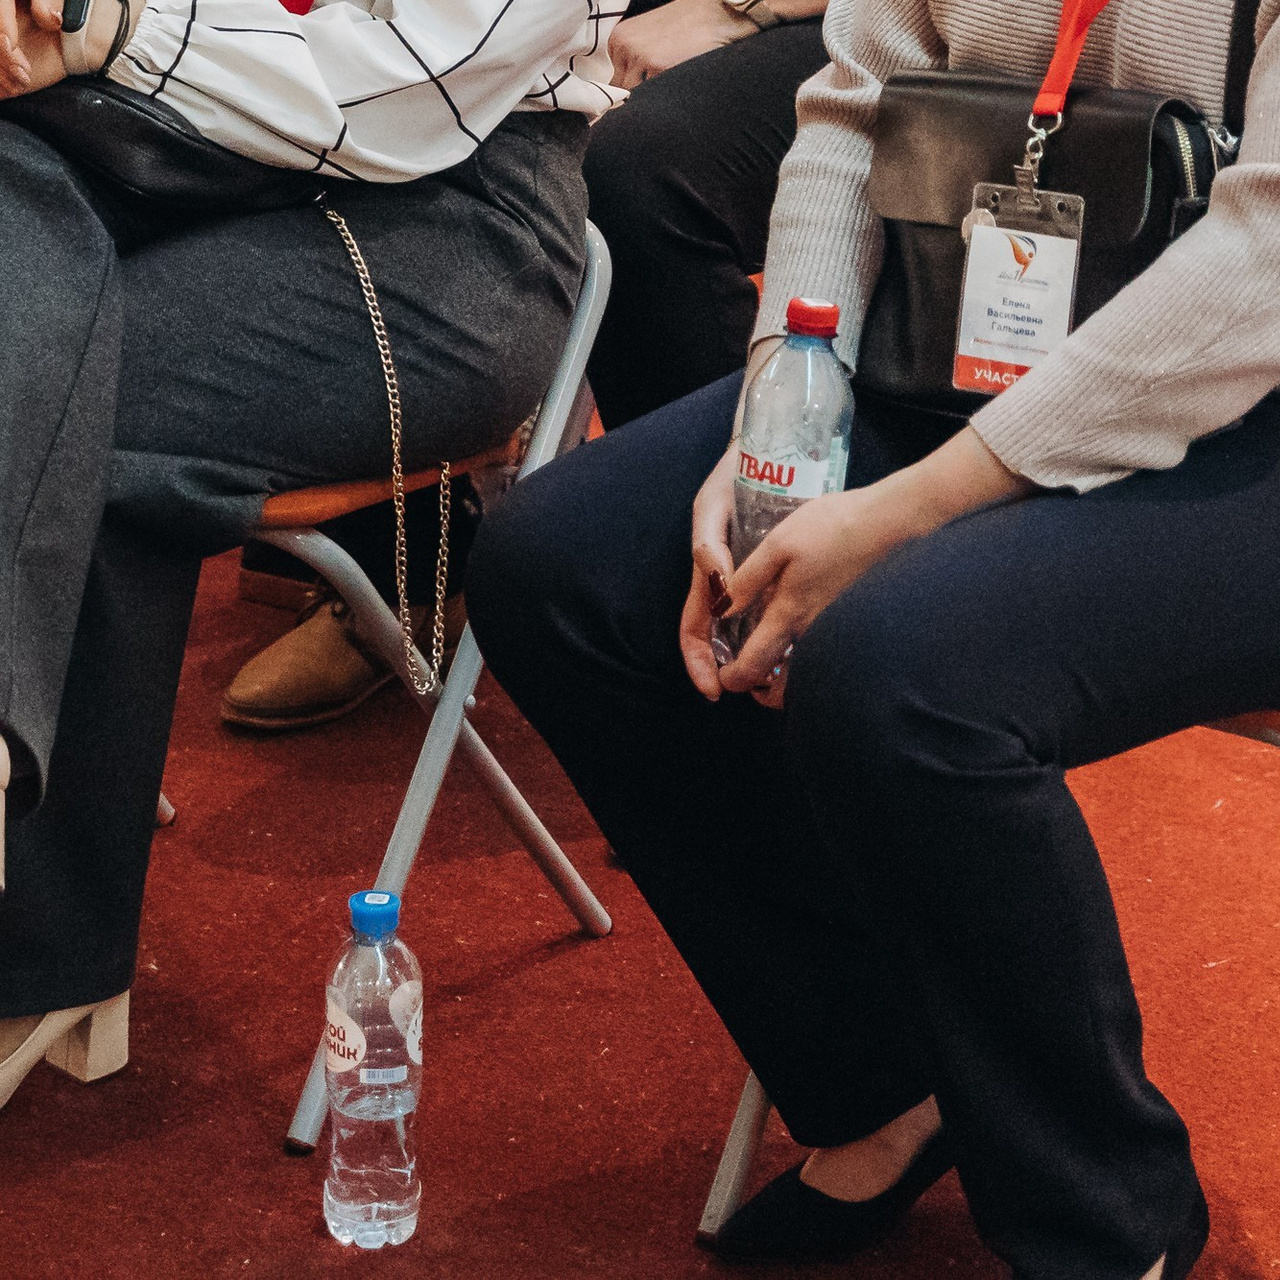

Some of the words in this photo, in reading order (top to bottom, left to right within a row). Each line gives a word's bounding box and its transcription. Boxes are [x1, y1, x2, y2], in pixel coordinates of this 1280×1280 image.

[1002, 296, 1031, 310] Елена
[987, 307, 1043, 325] Васильевна
[991, 321, 1036, 337] Гальцева
